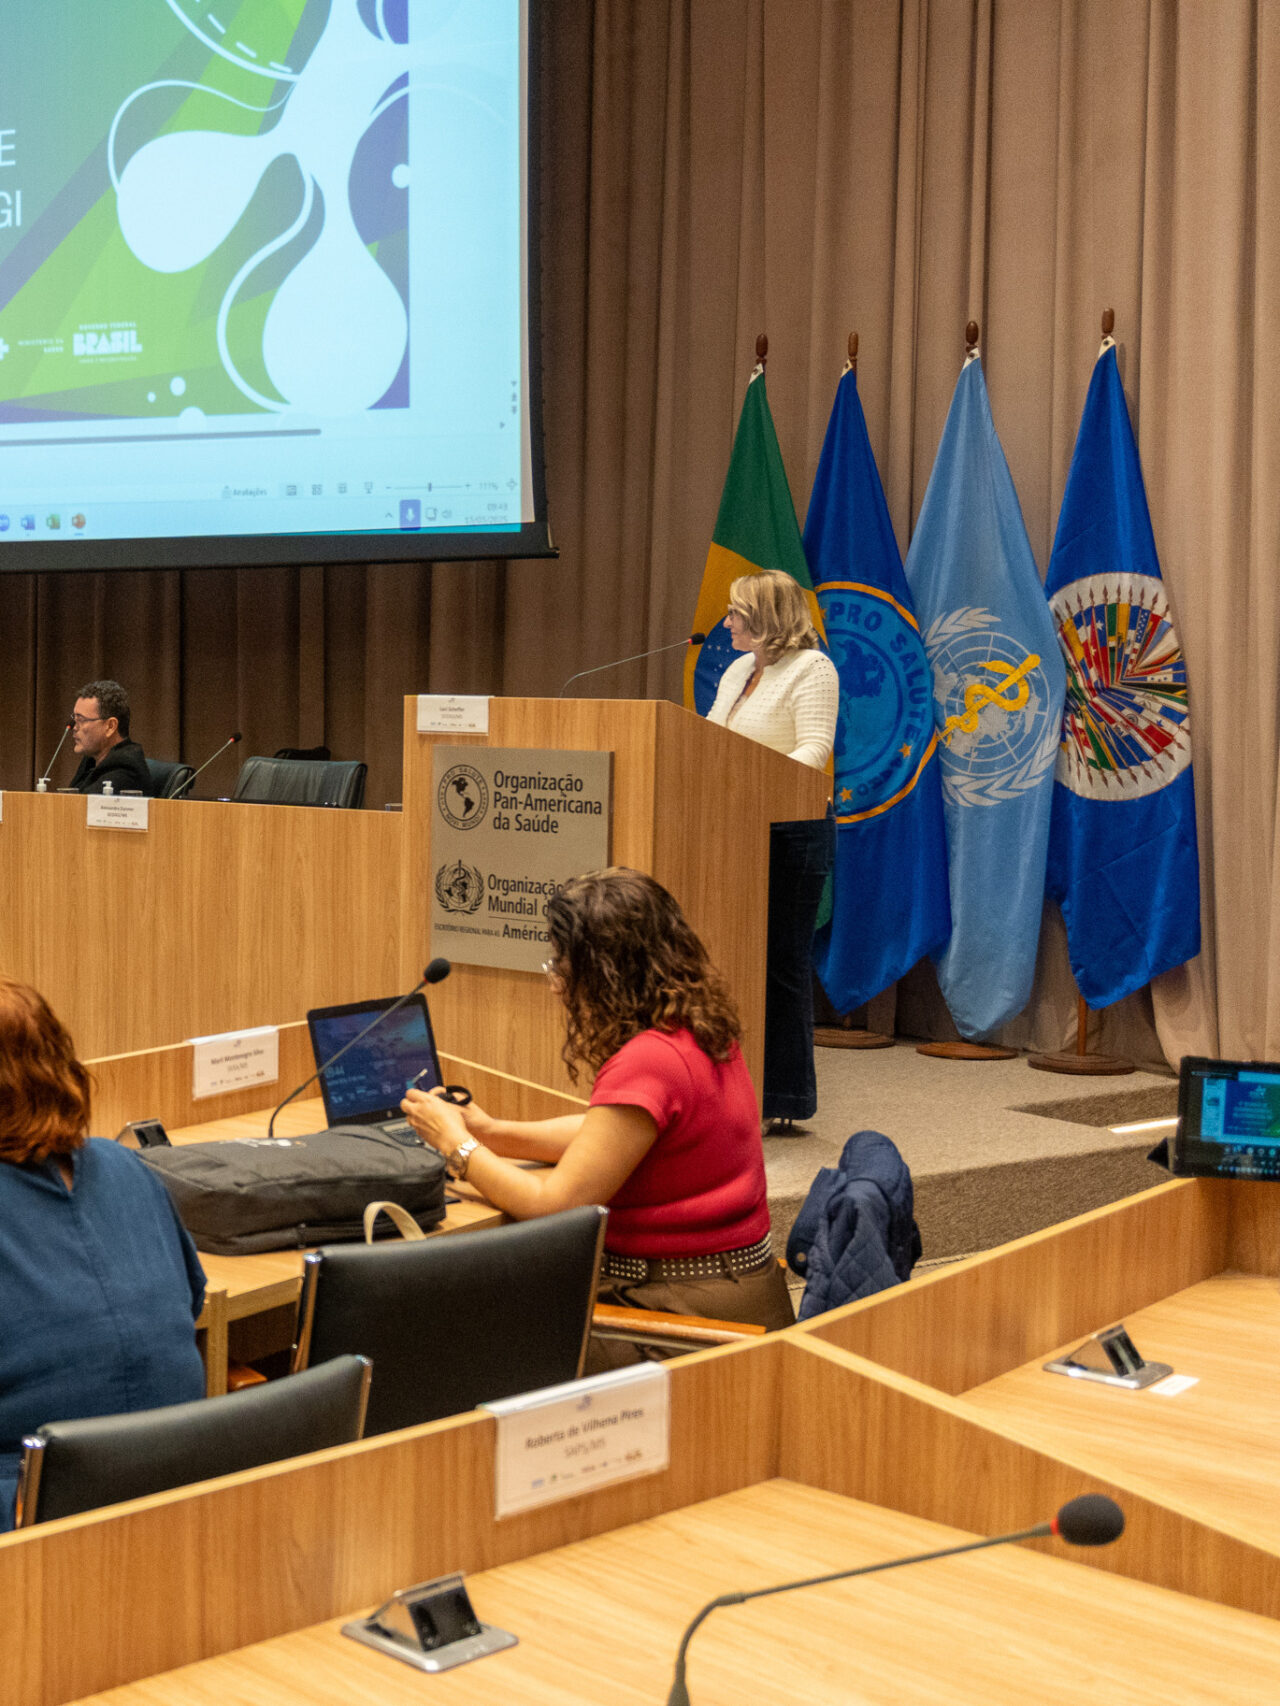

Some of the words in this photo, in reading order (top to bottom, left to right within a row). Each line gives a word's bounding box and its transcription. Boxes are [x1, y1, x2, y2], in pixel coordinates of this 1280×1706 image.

[73, 330, 143, 356] BRASIL
[829, 601, 882, 632] PRO
[890, 632, 928, 741] SALUTE
[494, 770, 584, 797] Organização
[493, 791, 602, 815] Pan-Americana
[493, 811, 510, 830] da
[515, 813, 559, 834] Saúde
[487, 873, 564, 899] Organização
[488, 895, 538, 916] Mundial
[502, 923, 551, 942] América
